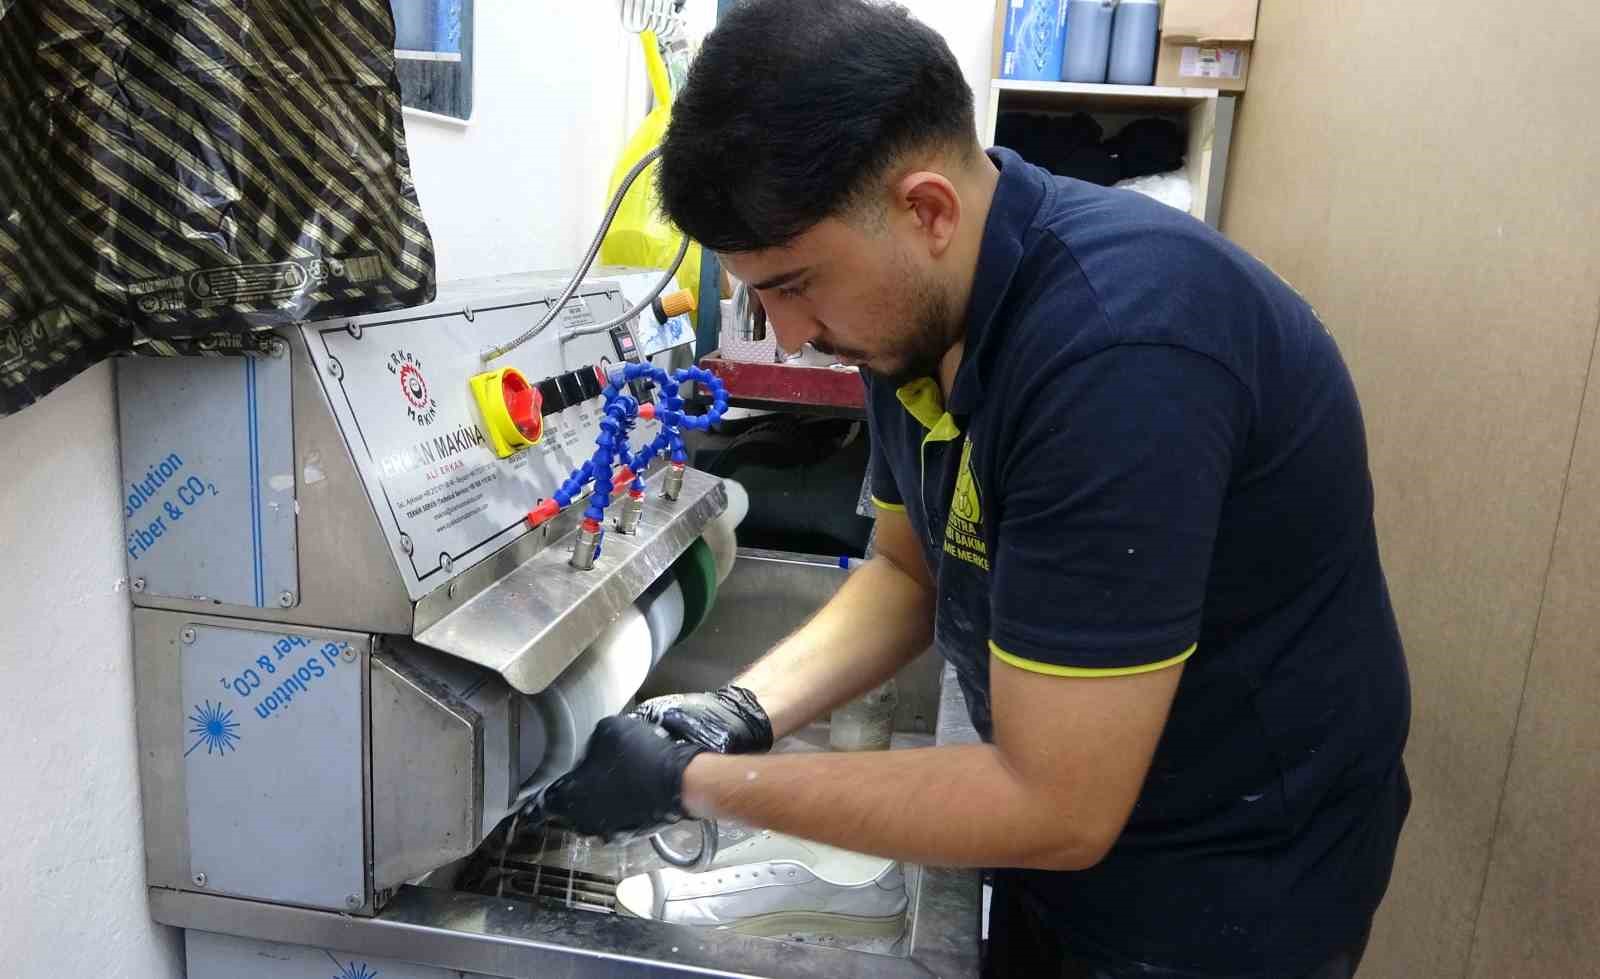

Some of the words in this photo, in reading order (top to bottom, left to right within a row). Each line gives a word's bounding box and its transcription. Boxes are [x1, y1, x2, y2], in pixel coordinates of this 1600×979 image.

[387, 350, 421, 375] ERKAN
[432, 423, 486, 461] MAKİNA
[163, 501, 184, 521] &
[256, 655, 276, 673] &
[255, 657, 325, 719] Solution
